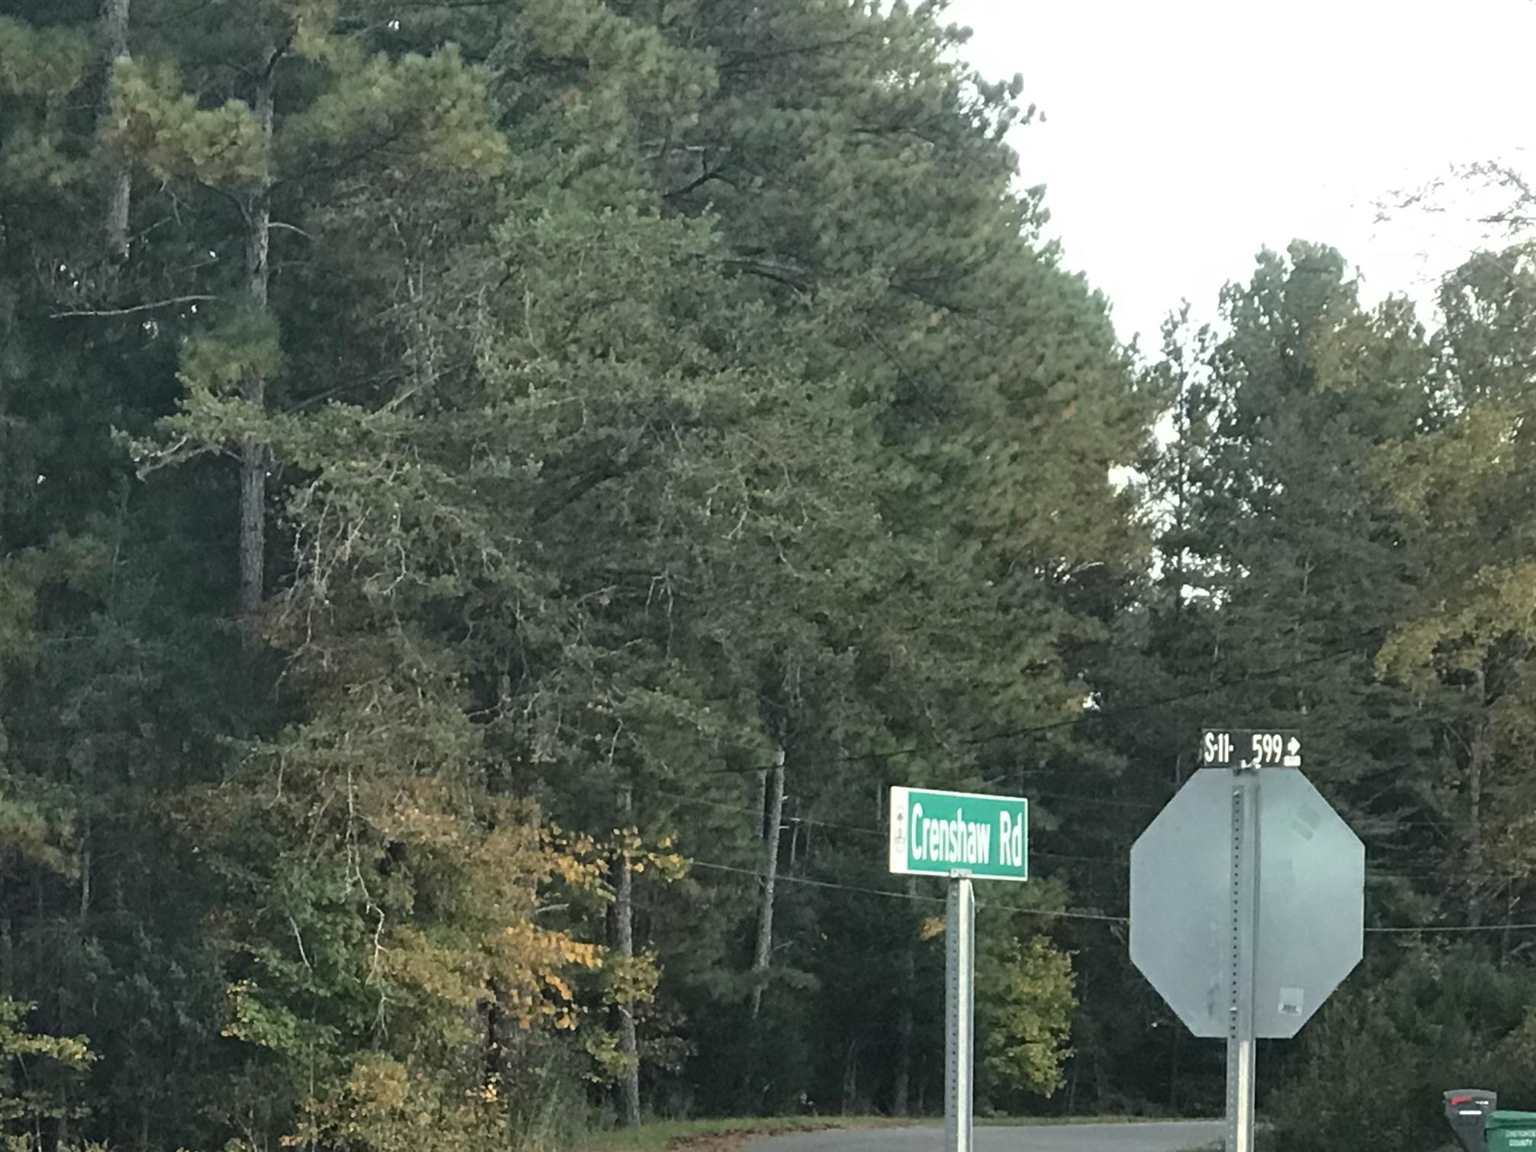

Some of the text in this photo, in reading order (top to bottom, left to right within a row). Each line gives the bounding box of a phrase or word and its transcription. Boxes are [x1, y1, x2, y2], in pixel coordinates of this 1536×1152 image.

[1252, 733, 1284, 764] 599
[911, 802, 1023, 867] Crenshaw Rd
